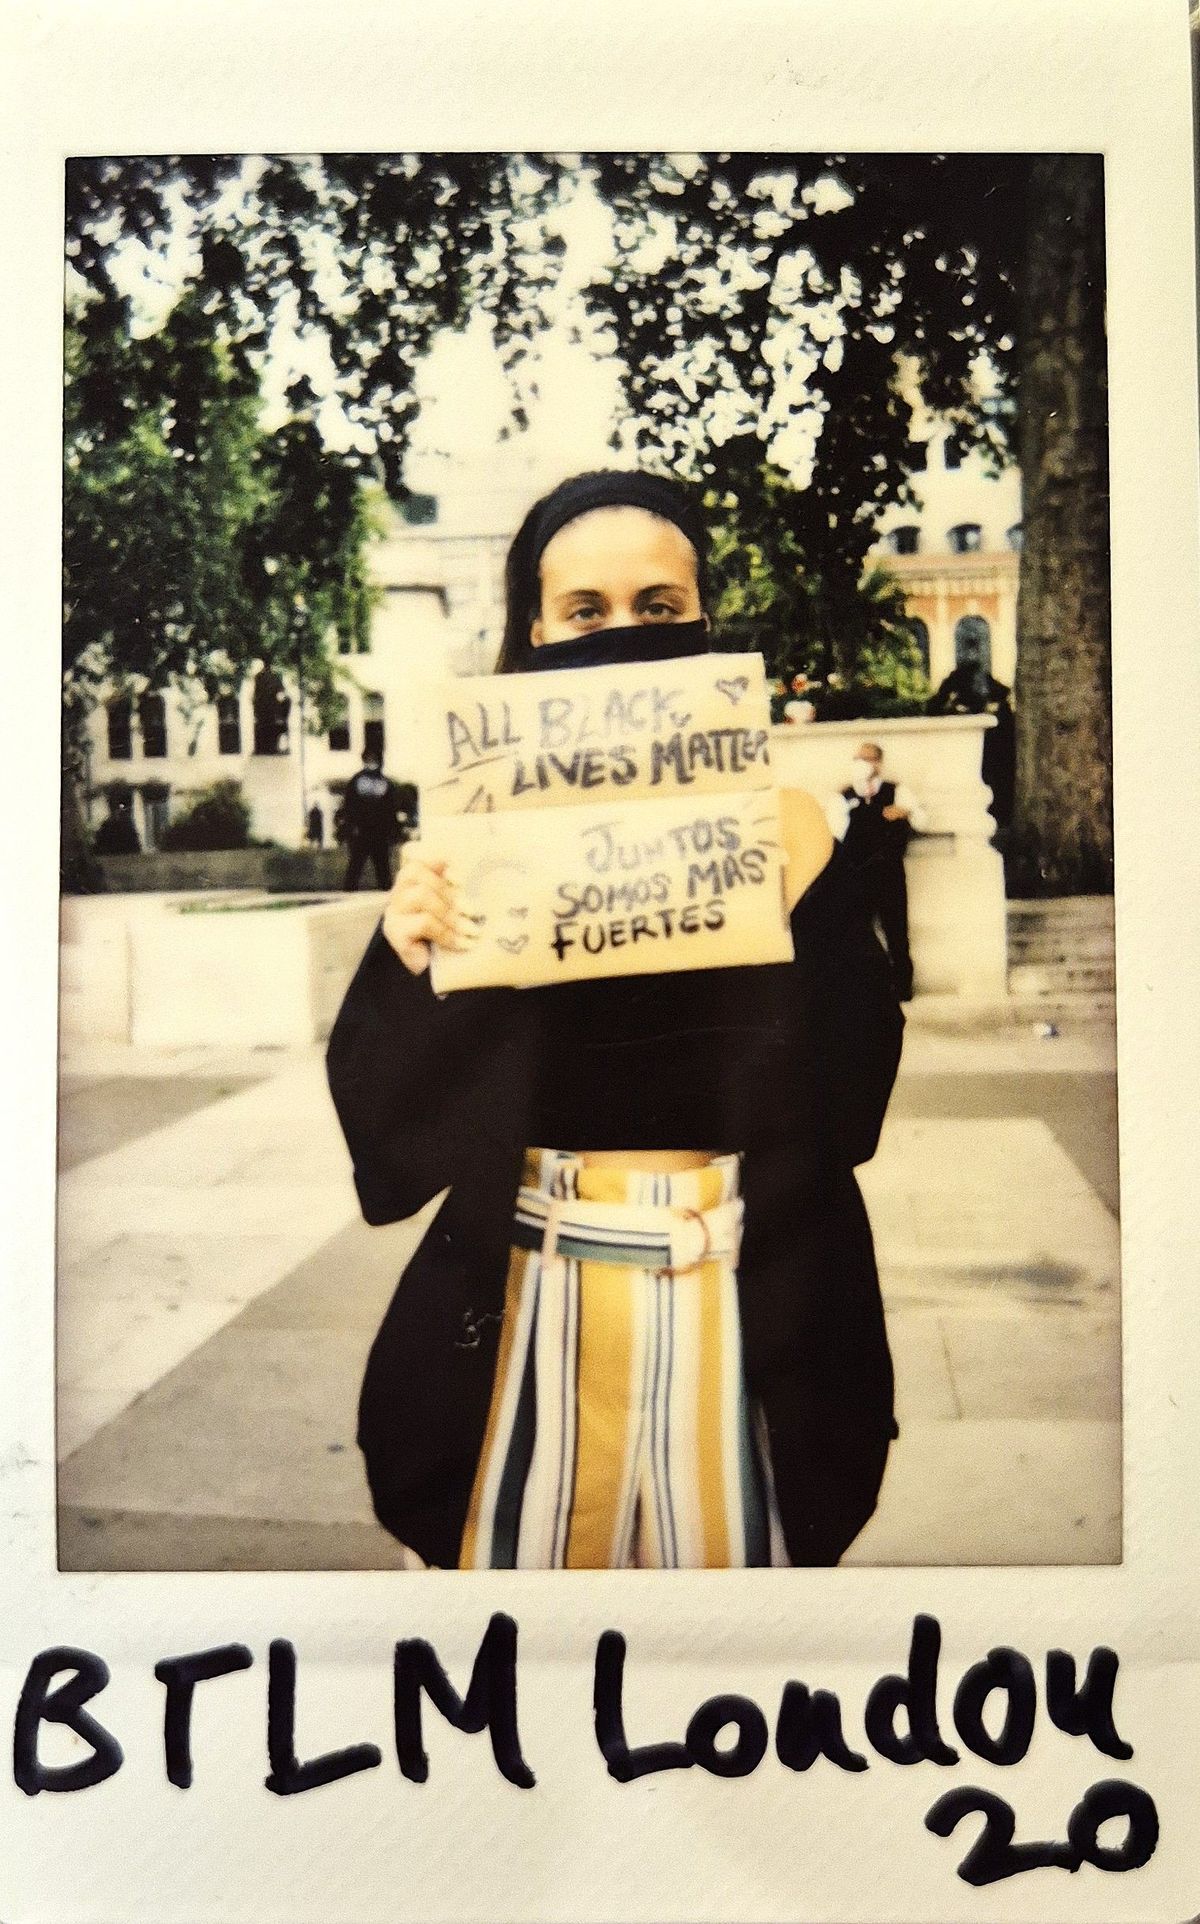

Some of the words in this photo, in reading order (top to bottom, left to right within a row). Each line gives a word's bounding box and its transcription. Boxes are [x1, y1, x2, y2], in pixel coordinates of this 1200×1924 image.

[447, 702, 522, 768] ALL
[539, 687, 684, 749] BLACK
[511, 743, 638, 796] LIVES
[649, 727, 771, 785] MATTER
[553, 872, 672, 919] SOMOS
[686, 848, 768, 899] MAS
[550, 899, 727, 961] FUERTES
[13, 1611, 537, 1796] BTLM
[924, 1778, 1161, 1887] 20
